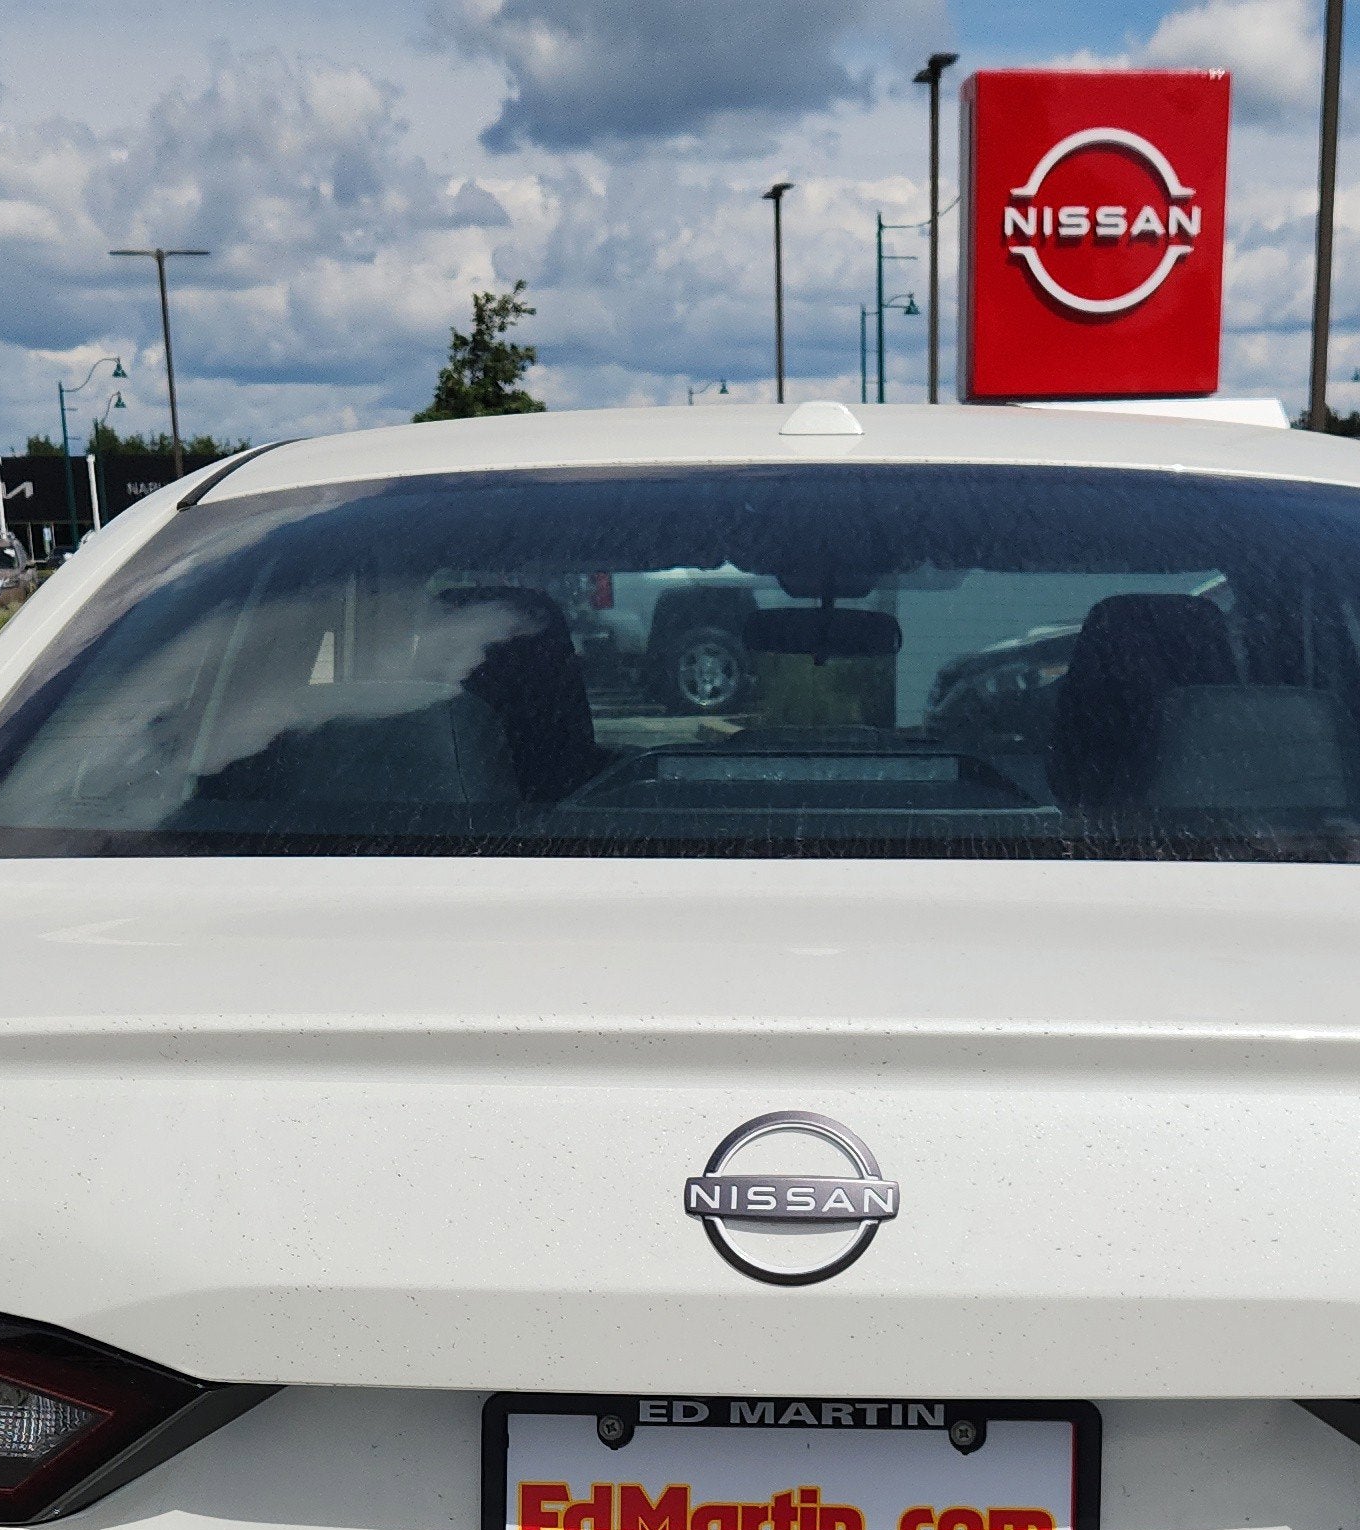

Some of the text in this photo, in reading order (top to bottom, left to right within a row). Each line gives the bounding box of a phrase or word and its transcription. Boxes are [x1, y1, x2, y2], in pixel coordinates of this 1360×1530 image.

[1003, 205, 1202, 238] NISSAN
[689, 1183, 895, 1214] NISSAN
[638, 1399, 947, 1428] ED MARTIN
